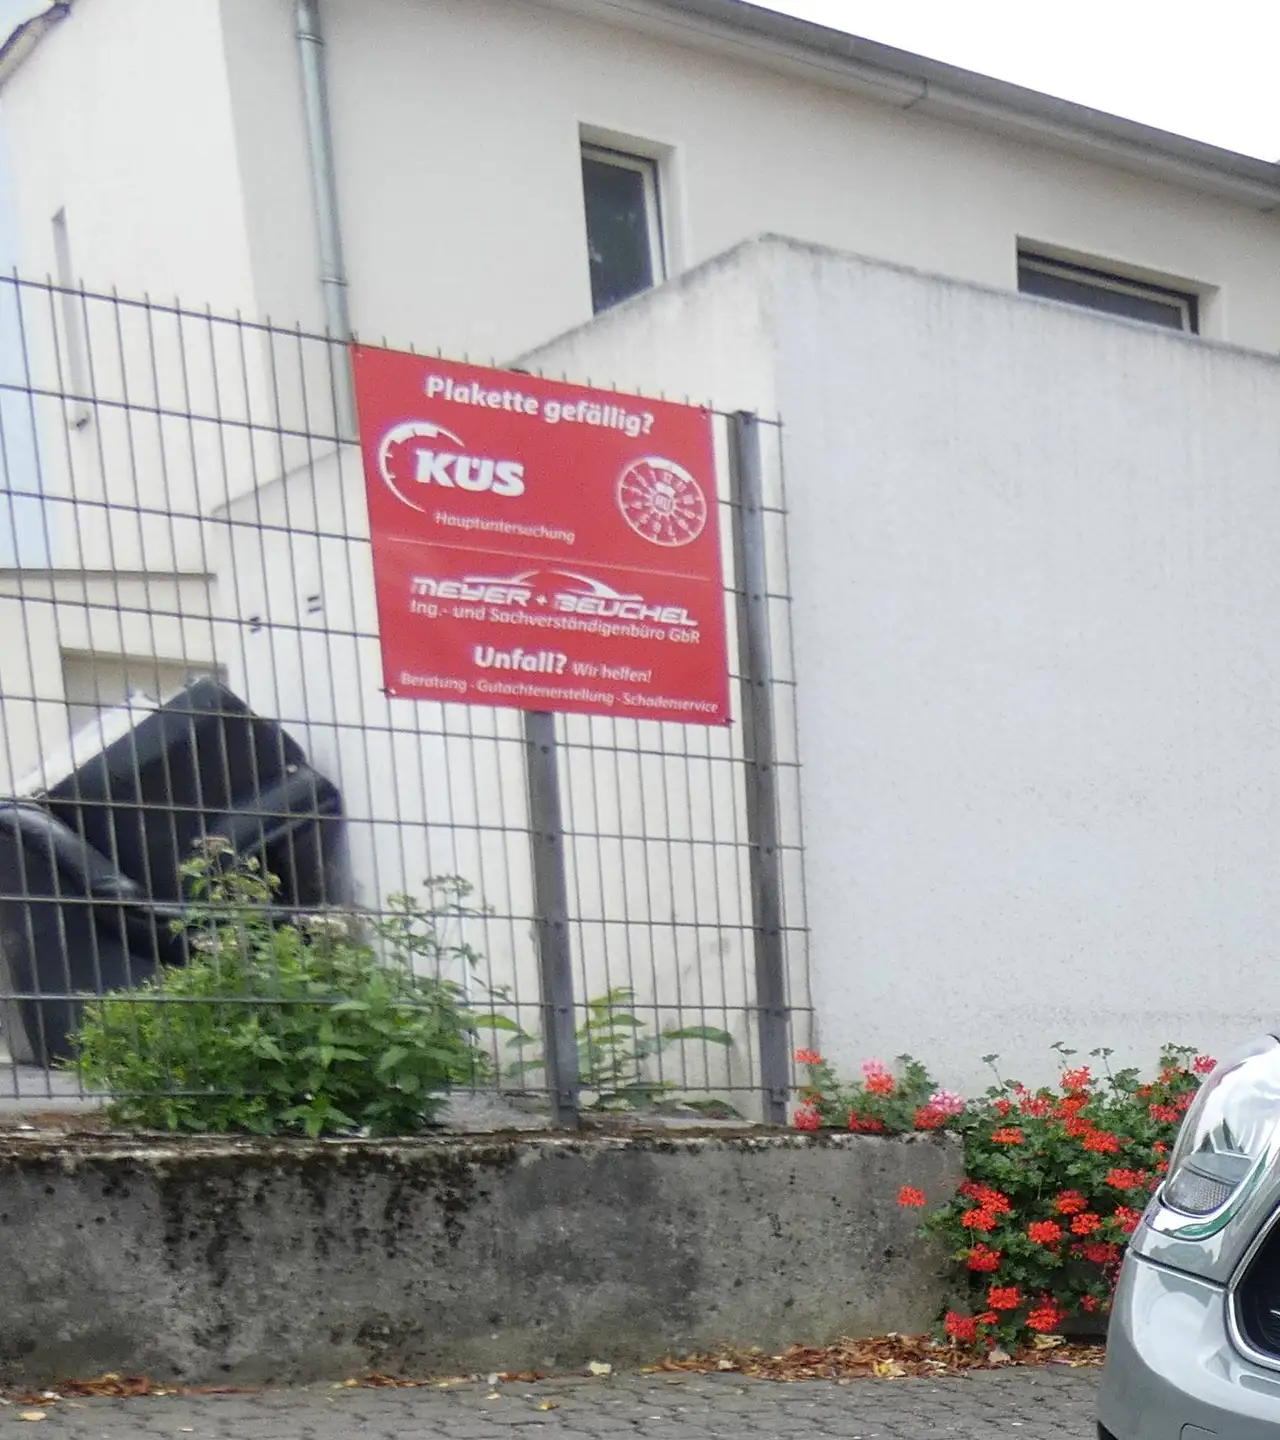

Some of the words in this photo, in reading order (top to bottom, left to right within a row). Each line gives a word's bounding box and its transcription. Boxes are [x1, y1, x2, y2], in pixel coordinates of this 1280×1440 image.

[426, 374, 539, 415] Plakette
[544, 400, 654, 437] gefällig?
[415, 450, 525, 496] KÜS
[435, 512, 575, 545] Hauptuntersuchung
[410, 577, 531, 606] MEYER
[554, 594, 698, 625] BEUCHEL
[410, 600, 448, 618] Ing.-
[453, 605, 486, 621] und
[489, 607, 665, 641] Sachverständigenbüro
[669, 628, 700, 644] GbR
[474, 645, 567, 675] Unfall?
[573, 662, 599, 678] Wir
[602, 663, 652, 683] helfen!
[400, 671, 467, 693] Beratung
[476, 679, 615, 706] Gutachtenerstellung
[622, 691, 719, 714] Schadenservice
